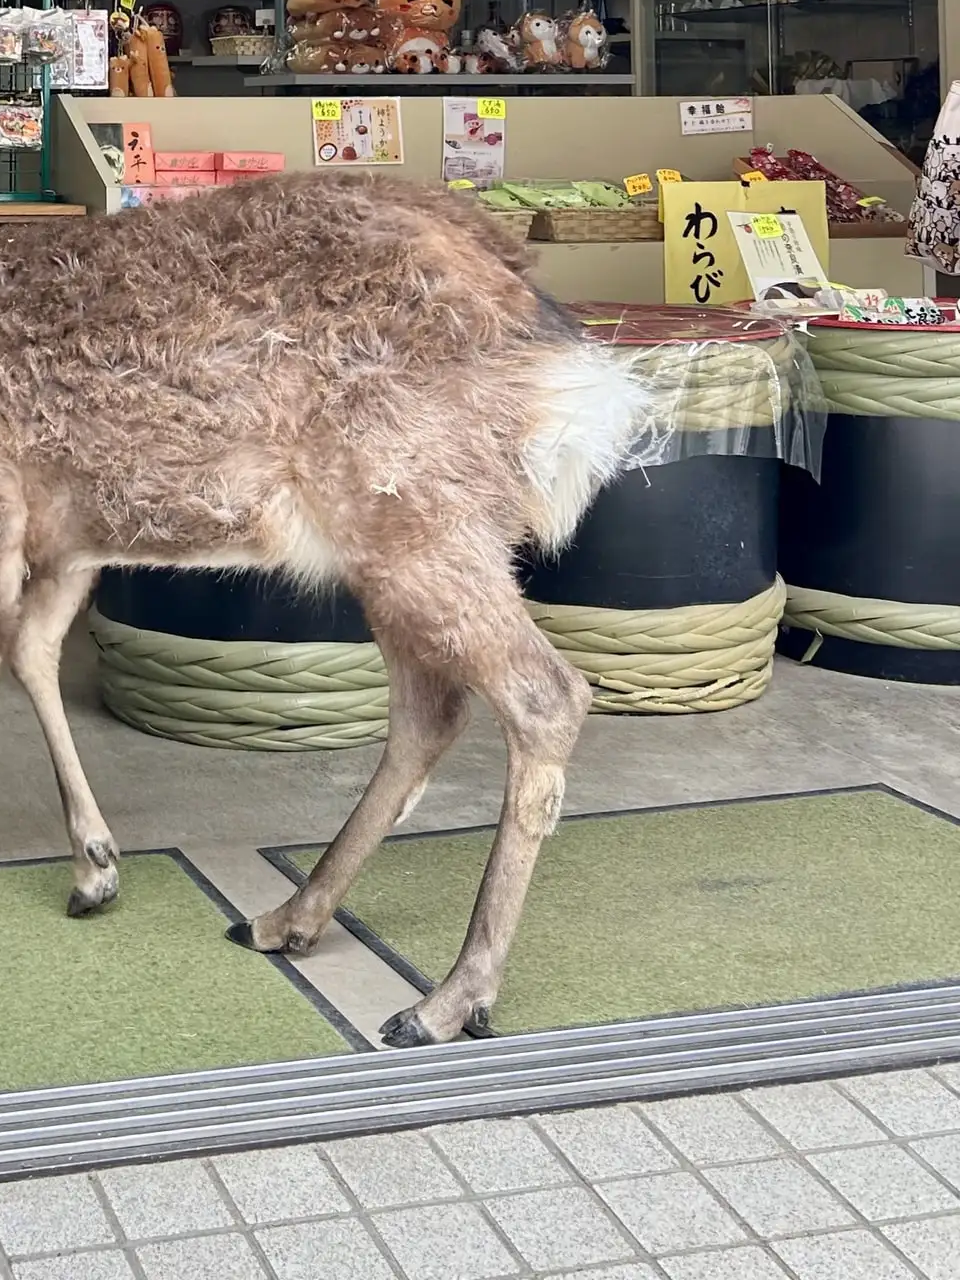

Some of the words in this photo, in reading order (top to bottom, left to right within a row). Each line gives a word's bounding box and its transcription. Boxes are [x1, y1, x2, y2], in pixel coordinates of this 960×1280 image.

[687, 103, 725, 116] 幸福飴
[682, 202, 724, 303] わらび
